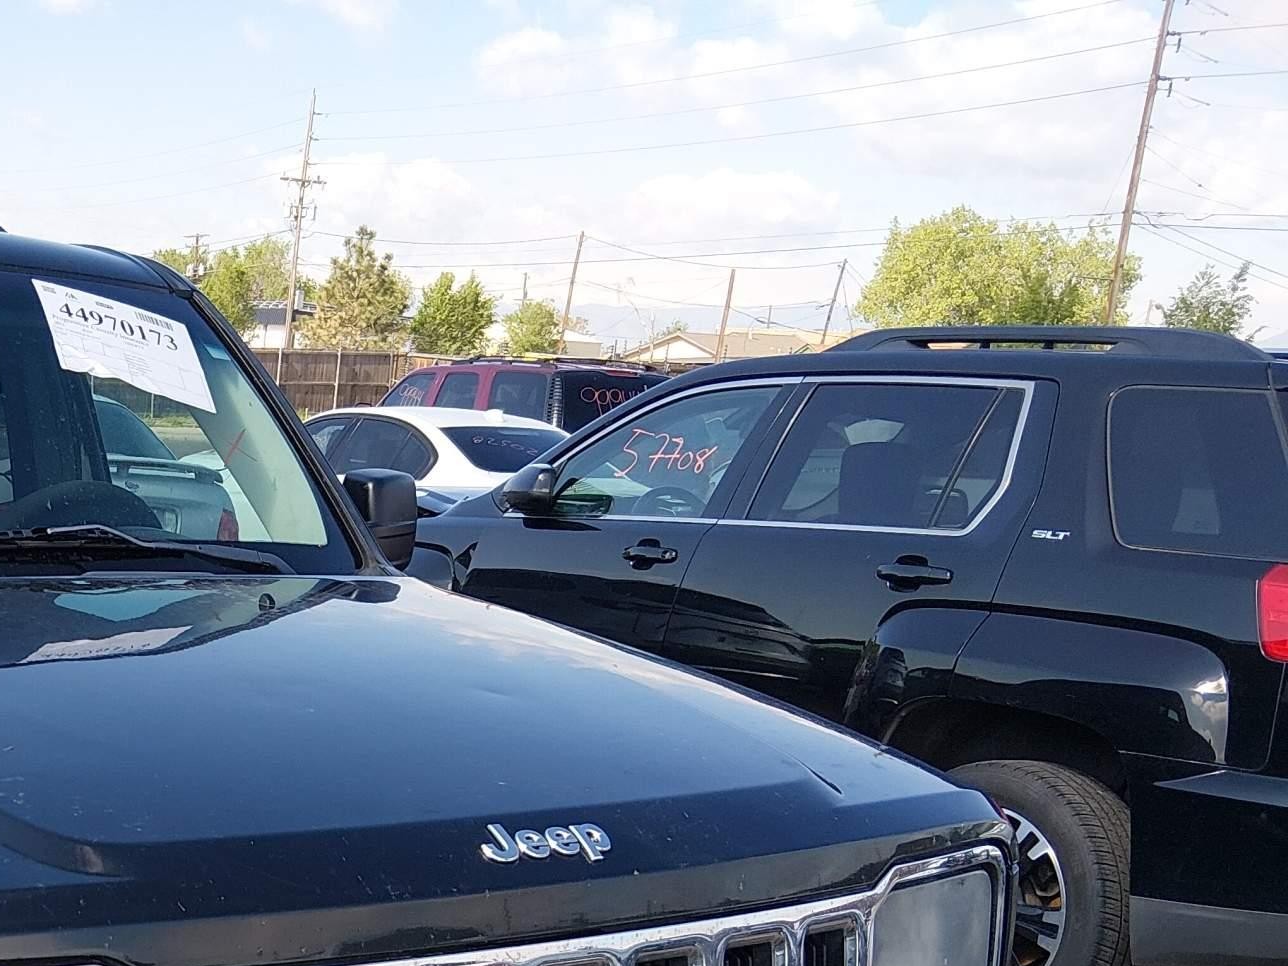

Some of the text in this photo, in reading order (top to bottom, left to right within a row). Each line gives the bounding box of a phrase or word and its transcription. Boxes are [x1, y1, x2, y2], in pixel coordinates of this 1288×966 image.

[59, 303, 178, 351] 44970173
[614, 428, 718, 477] 57708
[1031, 529, 1071, 541] SLT
[481, 823, 612, 863] Jeep
